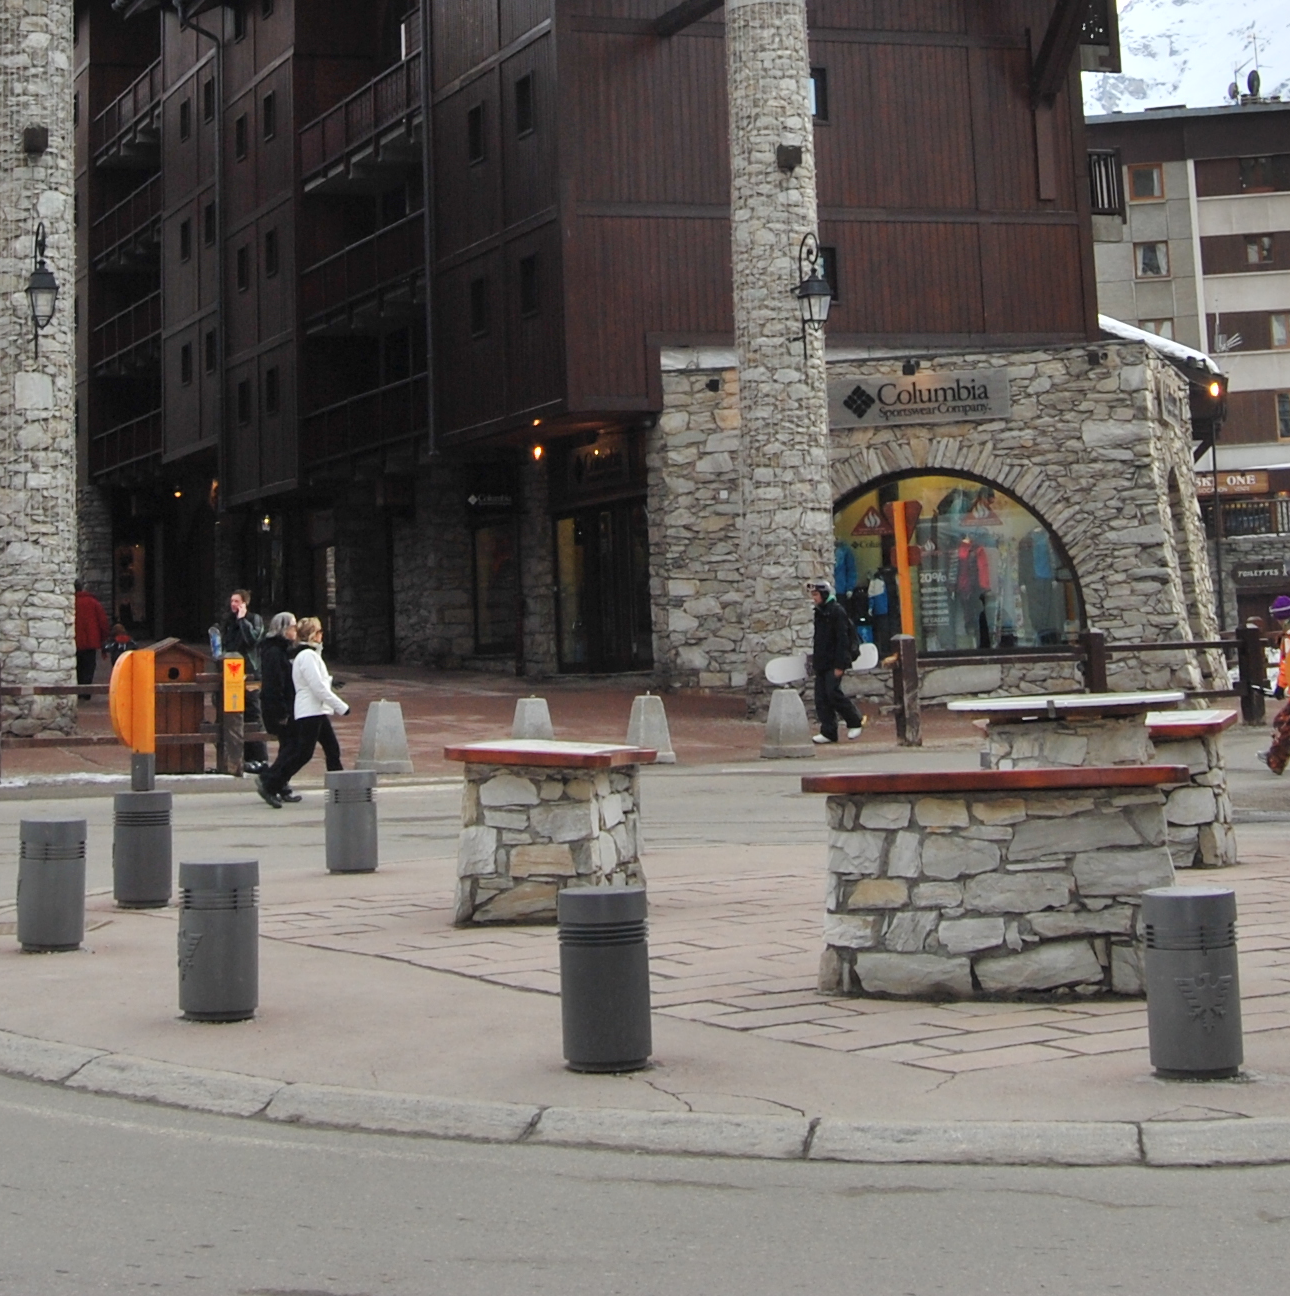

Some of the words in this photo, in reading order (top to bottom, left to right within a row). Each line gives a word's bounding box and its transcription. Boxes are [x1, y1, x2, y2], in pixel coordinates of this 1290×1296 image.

[877, 379, 989, 406] Columbia
[878, 406, 937, 420] Sportswear
[1226, 475, 1256, 485] ONE
[920, 572, 946, 583] 20%
[1238, 569, 1278, 577] TOILETTES
